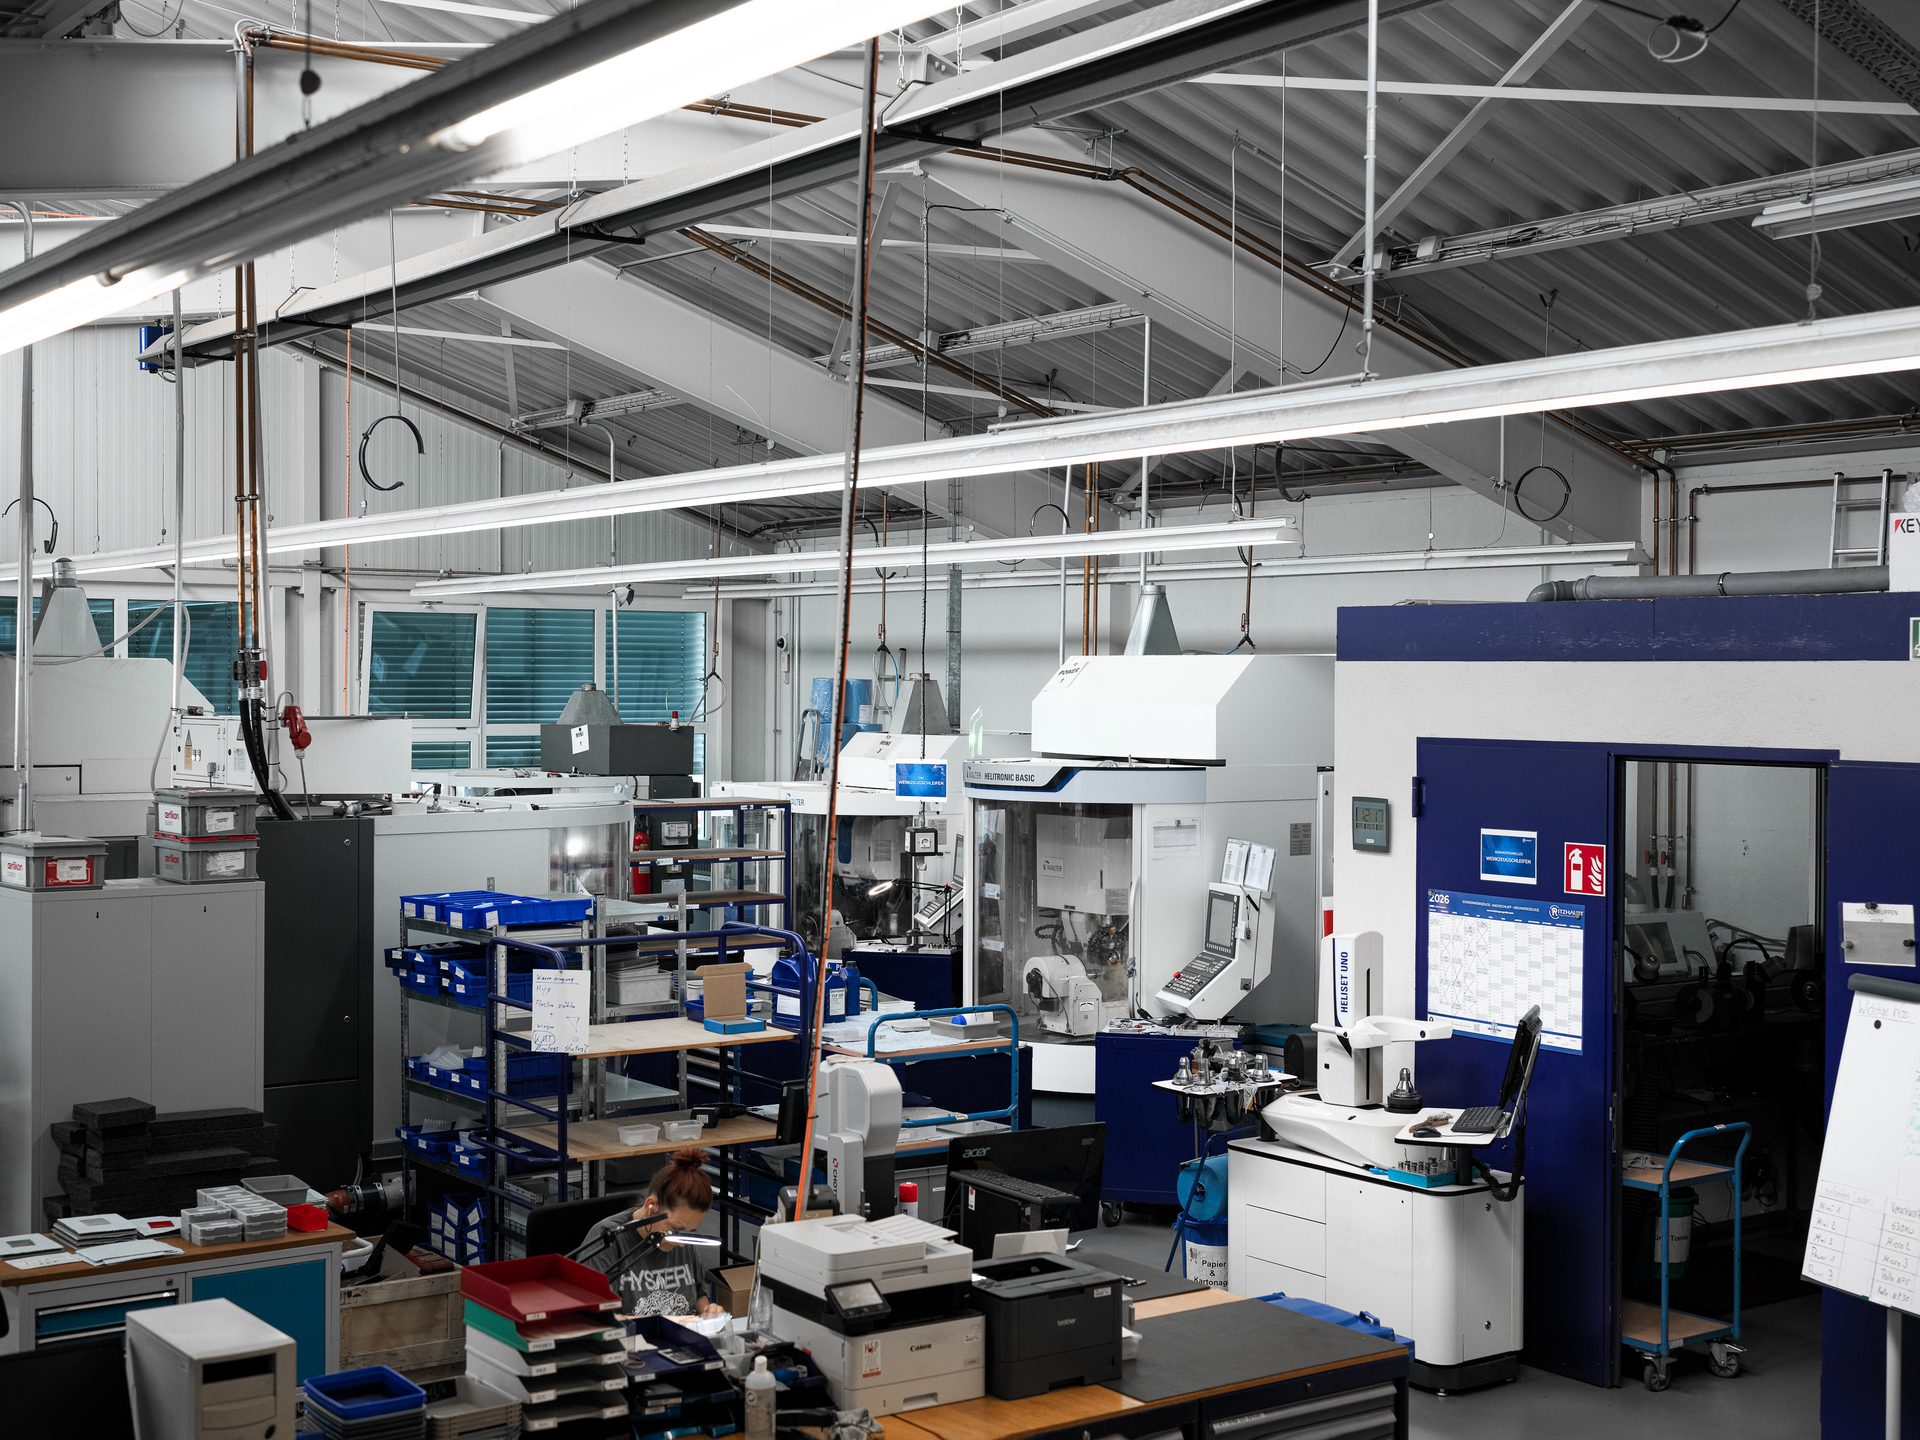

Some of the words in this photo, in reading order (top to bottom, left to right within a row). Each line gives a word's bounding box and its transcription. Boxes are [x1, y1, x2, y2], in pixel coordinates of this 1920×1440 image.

[985, 772, 1014, 782] HELITRONIC
[1015, 774, 1035, 782] BASIC
[1429, 893, 1449, 905] 2026
[1340, 951, 1348, 973] UNO
[1340, 975, 1348, 1013] HELISET
[963, 1147, 991, 1158] acer
[1202, 1260, 1227, 1268] Papier
[619, 1264, 696, 1292] HYSTERI
[1056, 1318, 1077, 1327] brother
[910, 1343, 932, 1352] Canon
